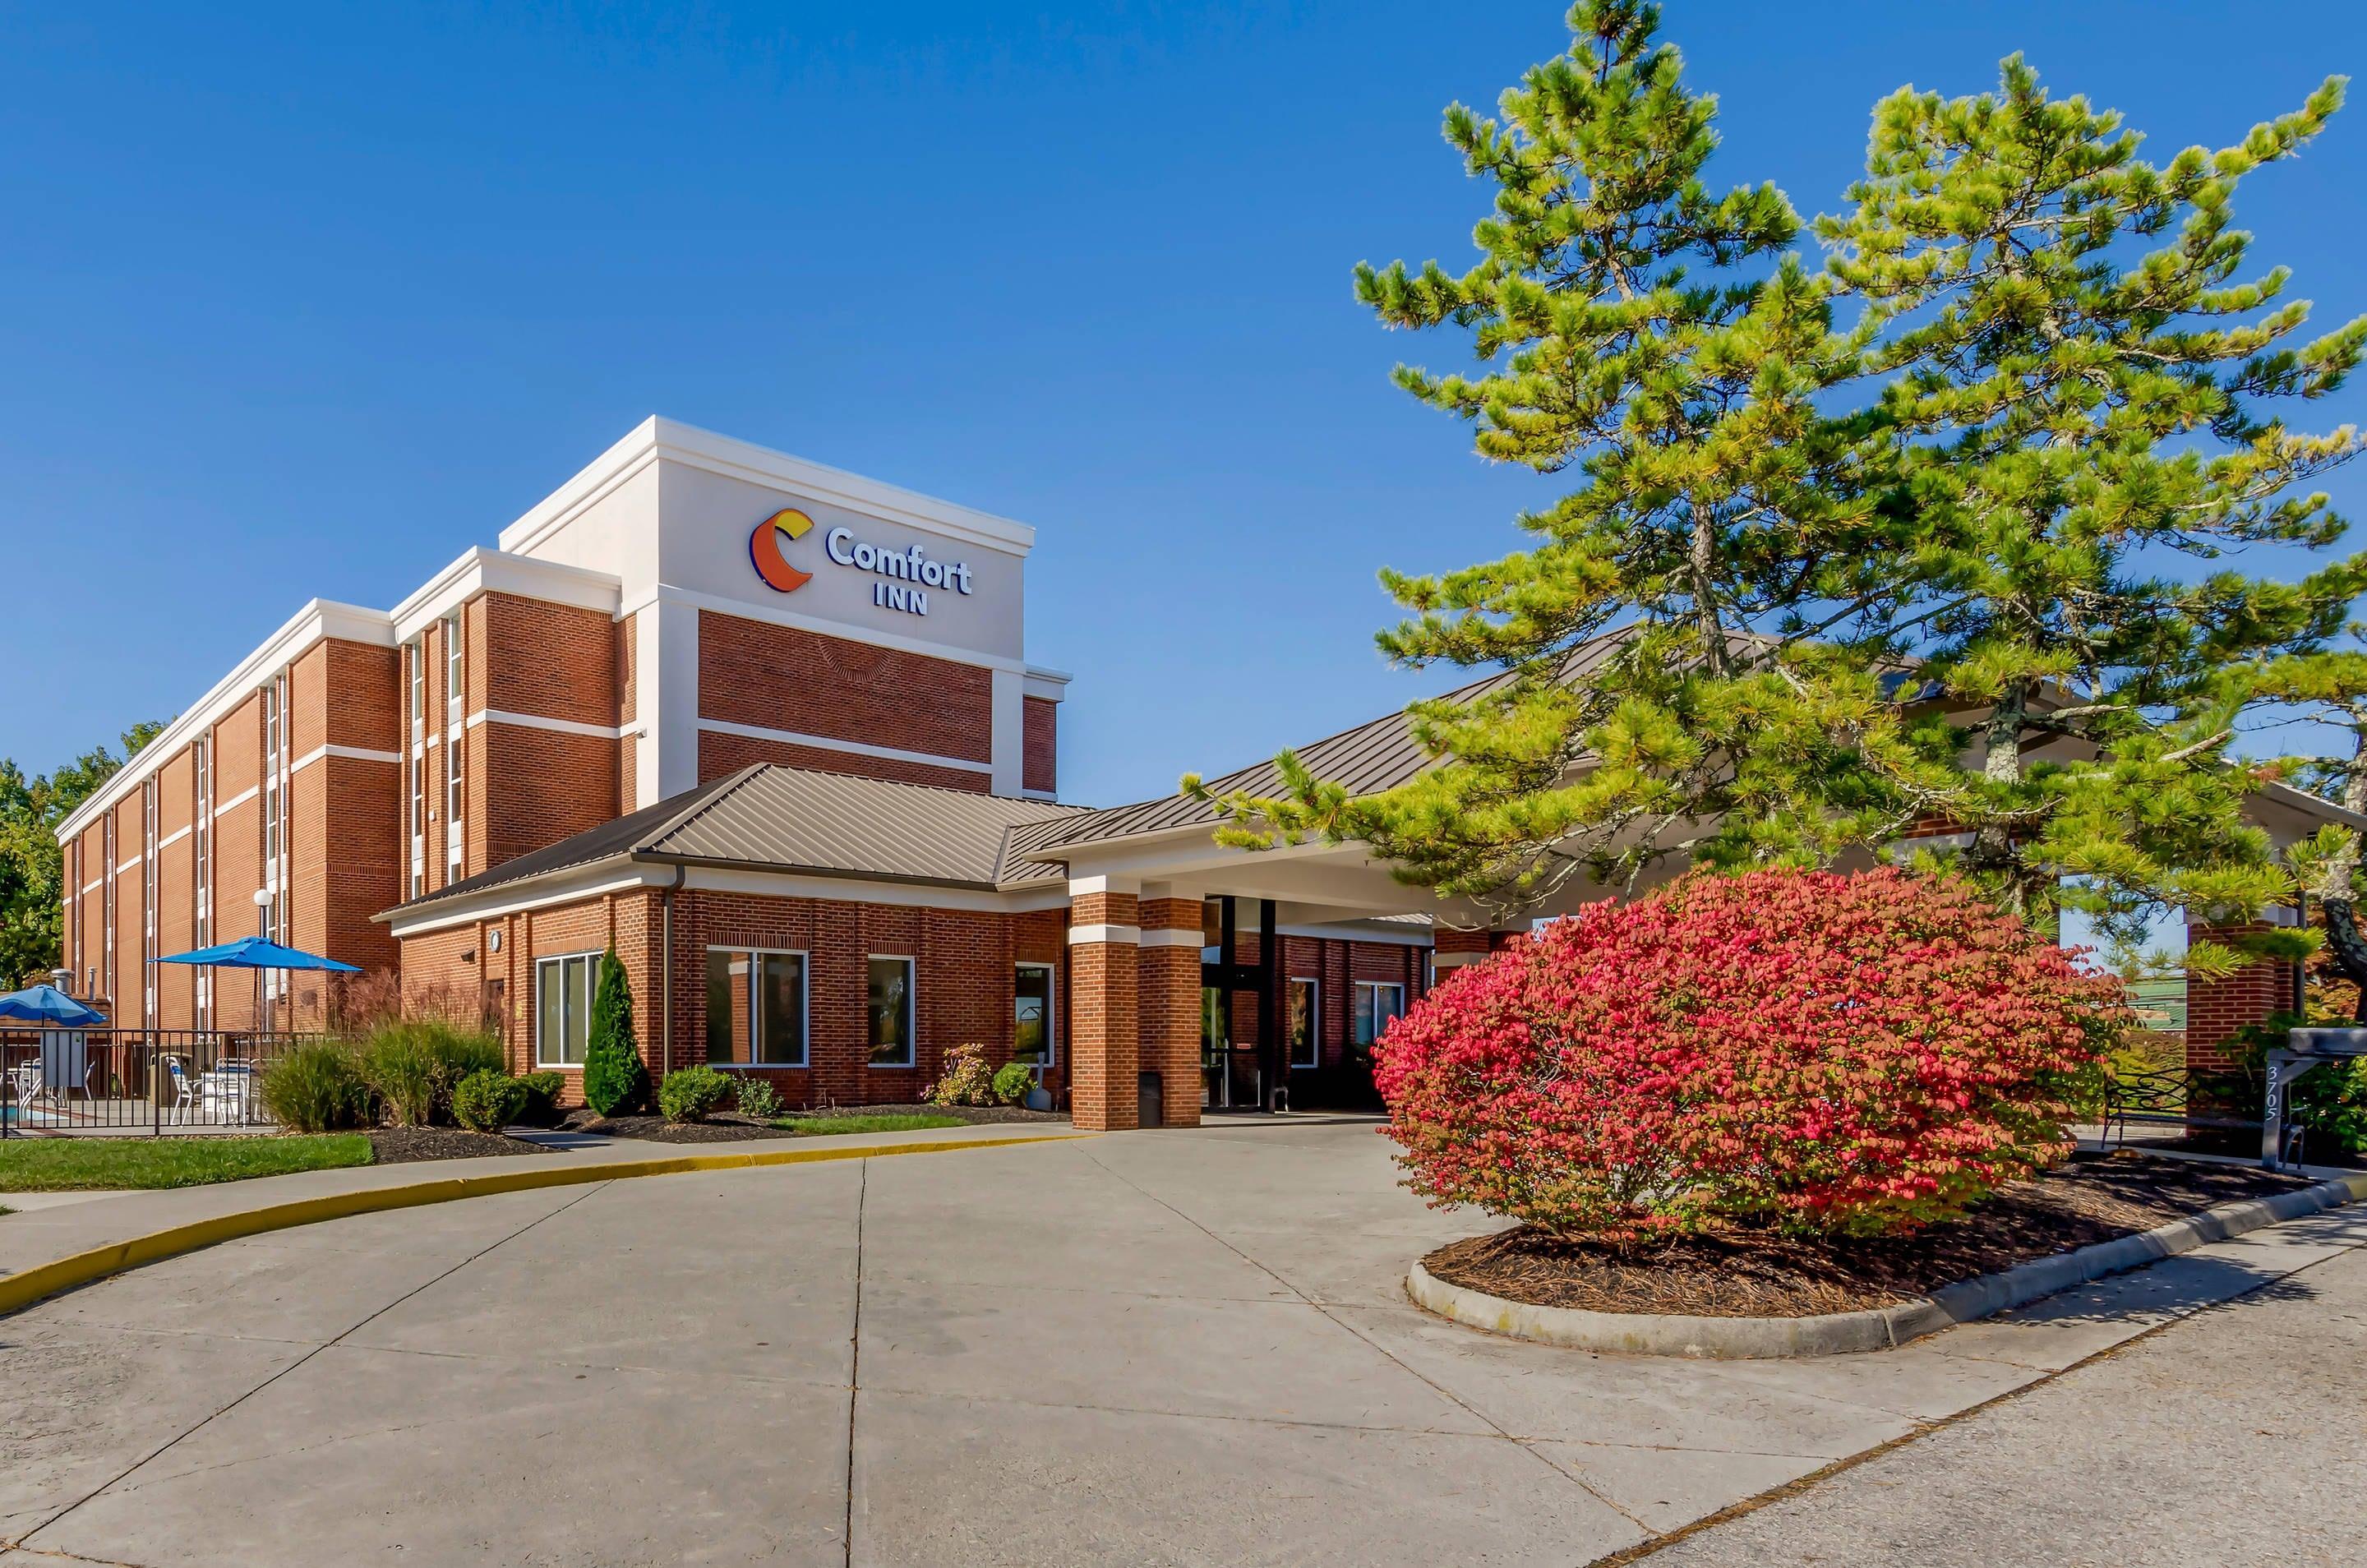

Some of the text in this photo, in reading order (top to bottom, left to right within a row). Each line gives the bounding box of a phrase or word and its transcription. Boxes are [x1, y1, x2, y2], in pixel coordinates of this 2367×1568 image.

[825, 527, 972, 595] Comfort
[874, 582, 928, 616] INN
[2266, 1067, 2277, 1121] 3705
